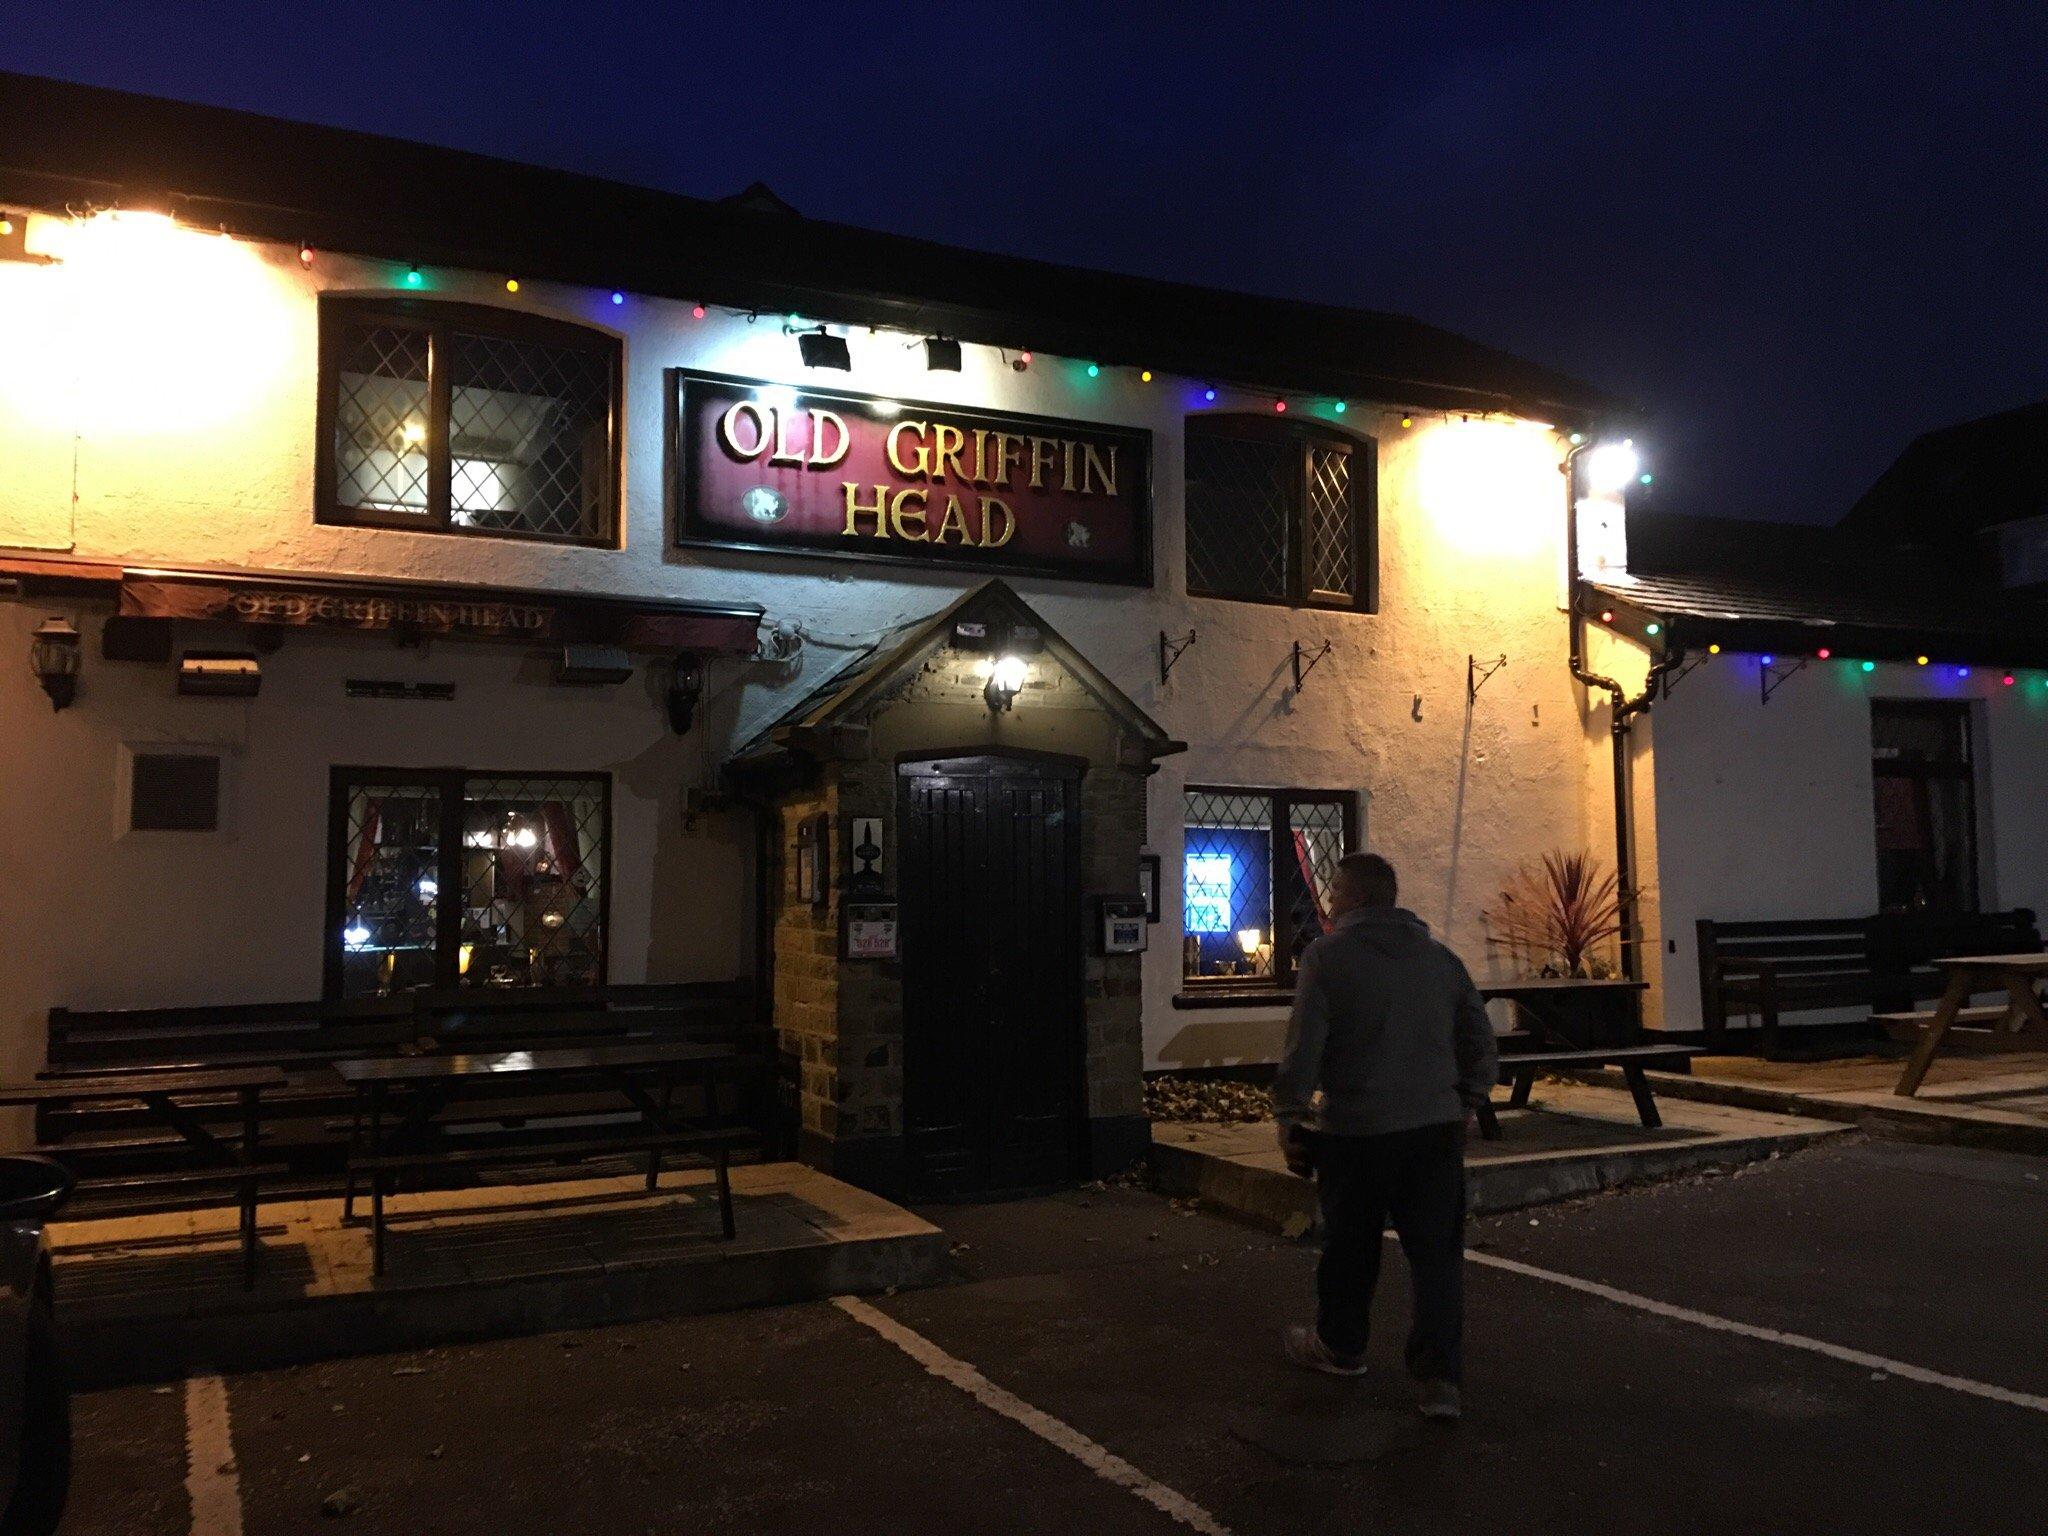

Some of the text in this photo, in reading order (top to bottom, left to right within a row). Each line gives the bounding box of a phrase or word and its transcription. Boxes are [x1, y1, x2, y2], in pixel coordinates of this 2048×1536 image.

[722, 401, 1119, 496] OLD GRIFFIN
[841, 481, 1017, 549] HEAD
[235, 593, 307, 616] OLD
[458, 604, 546, 630] HEAD
